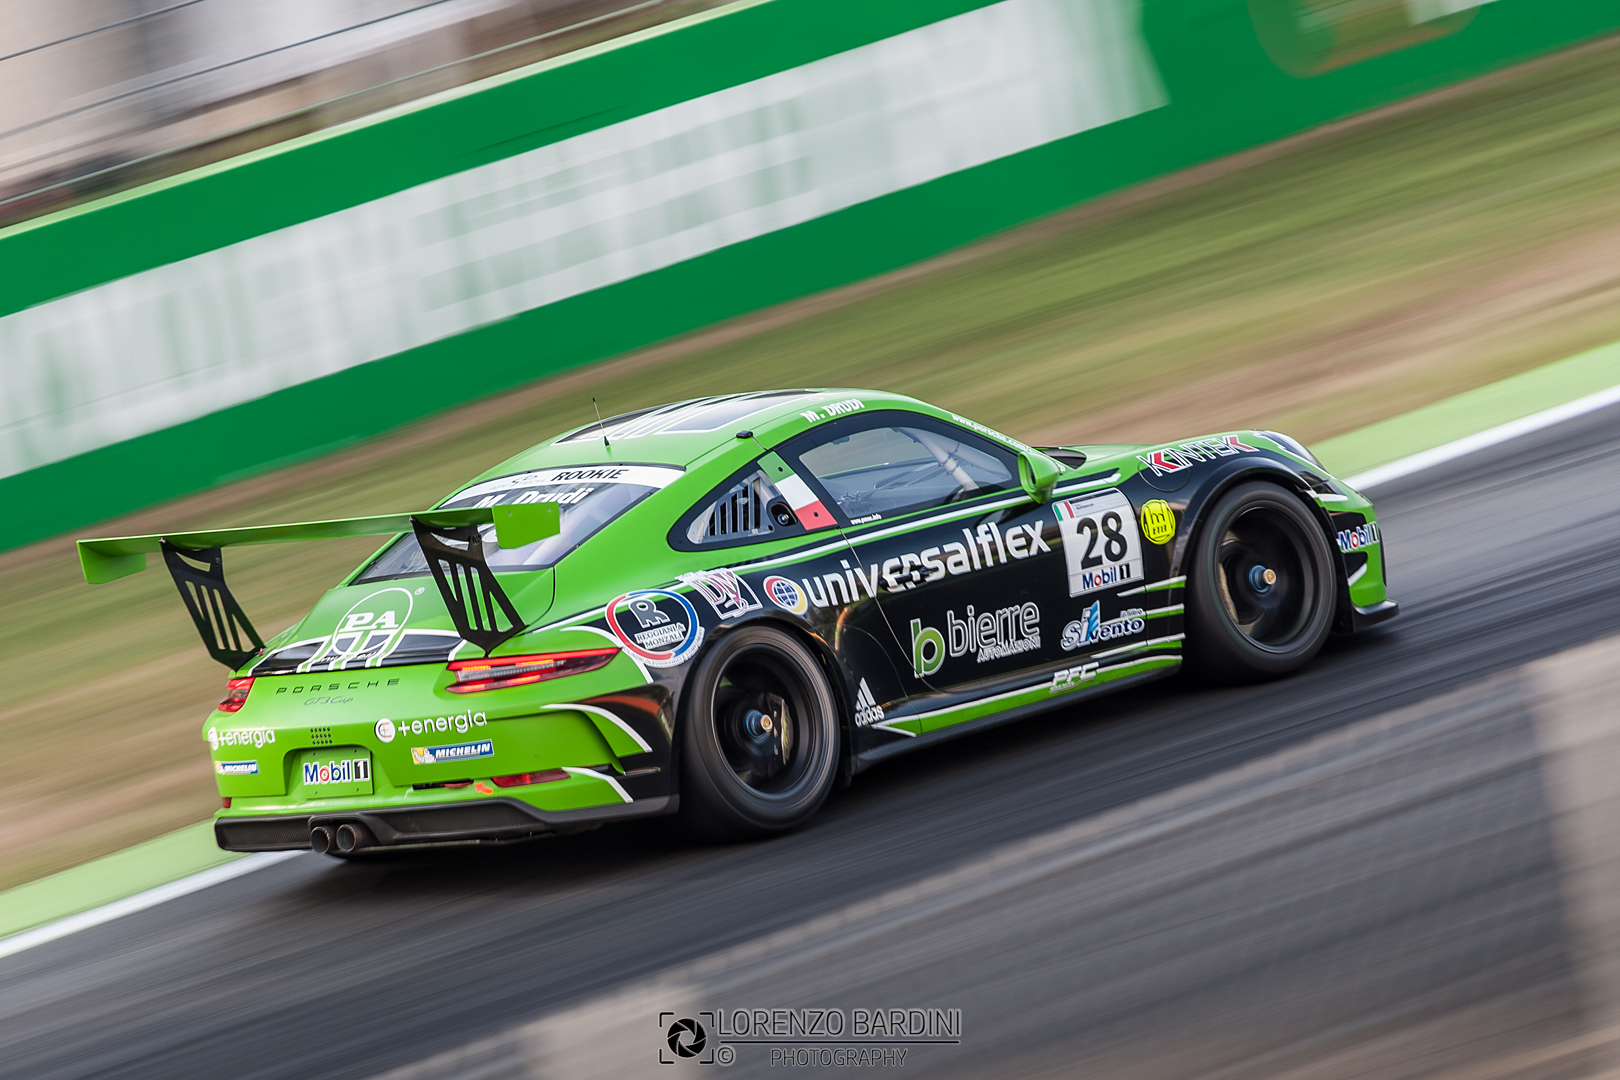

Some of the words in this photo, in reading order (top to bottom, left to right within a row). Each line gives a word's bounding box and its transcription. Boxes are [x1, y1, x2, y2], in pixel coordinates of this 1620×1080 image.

[799, 410, 826, 423] M.
[821, 399, 865, 417] DRUDI
[1136, 434, 1261, 477] KINTEK
[551, 468, 630, 482] ROOKIE
[1076, 511, 1128, 570] 28
[1338, 523, 1372, 553] Mobil
[1369, 521, 1380, 543] 1
[801, 520, 1052, 608] universalflex
[1082, 566, 1117, 590] Mobil
[1119, 563, 1131, 580] 1
[338, 610, 399, 633] PA
[634, 624, 676, 643] REGGIANI
[947, 601, 1040, 657] bierre
[643, 634, 685, 650] MONZALI
[976, 635, 1041, 663] AUTOMAZIONI
[276, 678, 400, 694] PORSCHE
[1053, 662, 1099, 687] PFC
[304, 697, 331, 706] GT3
[330, 696, 354, 705] Cup
[855, 705, 885, 727] adidas
[435, 742, 491, 758] MICHELIN
[222, 762, 257, 774] MICHELIN
[303, 761, 352, 785] Mobil
[353, 759, 370, 782] 1
